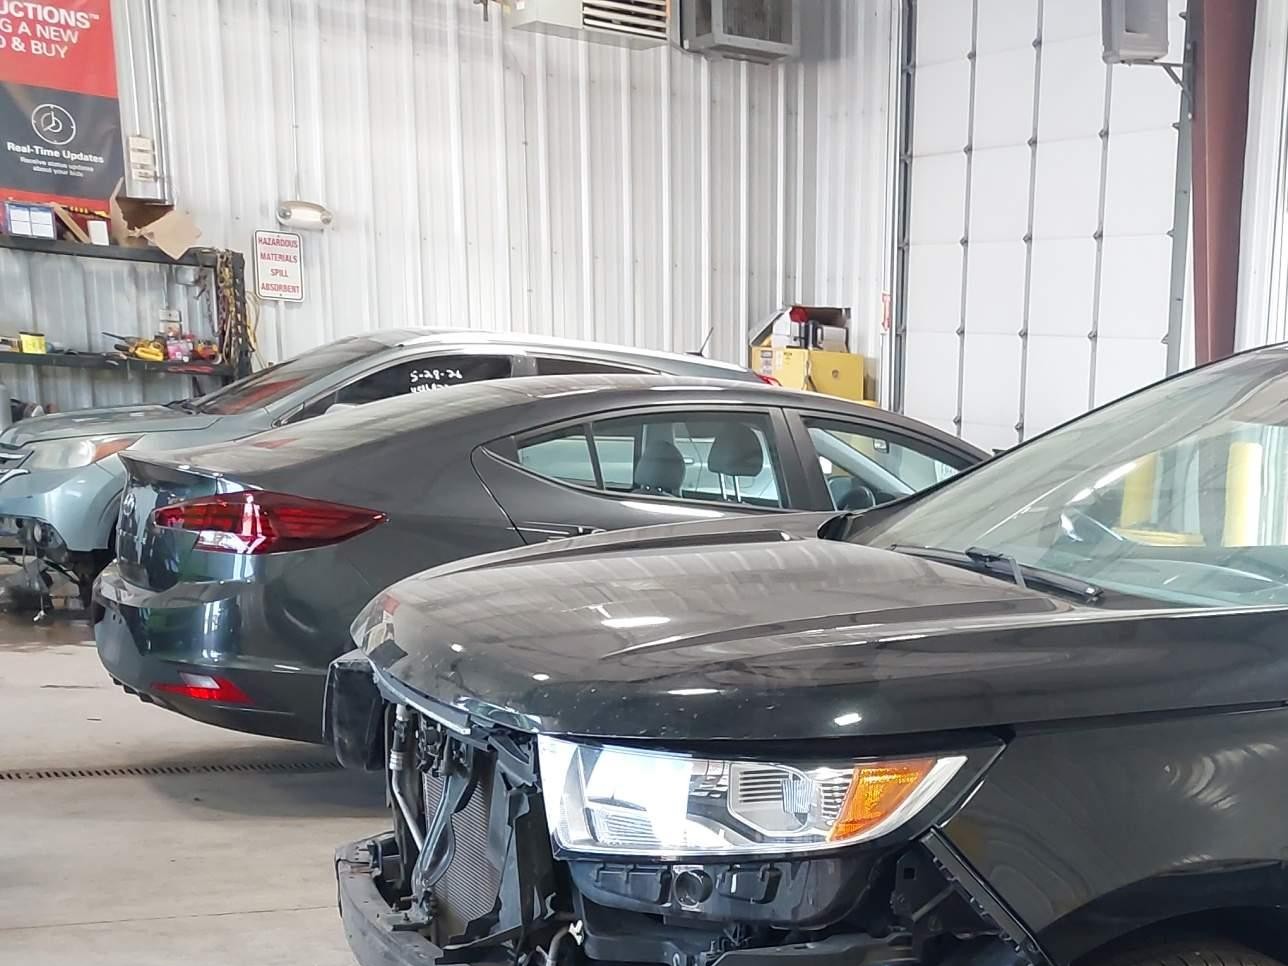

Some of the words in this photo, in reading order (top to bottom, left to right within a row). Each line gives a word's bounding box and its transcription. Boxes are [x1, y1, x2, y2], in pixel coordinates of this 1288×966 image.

[18, 21, 32, 36] A
[36, 24, 78, 44] NEW
[12, 37, 26, 52] &
[31, 40, 68, 58] BUY
[7, 141, 60, 157] Real-Time
[62, 150, 104, 163] Updates
[258, 237, 298, 248] HAZARDOUS
[260, 252, 297, 263] MATERIALS
[271, 268, 288, 277] SPILL
[261, 283, 299, 293] ABSORBENT
